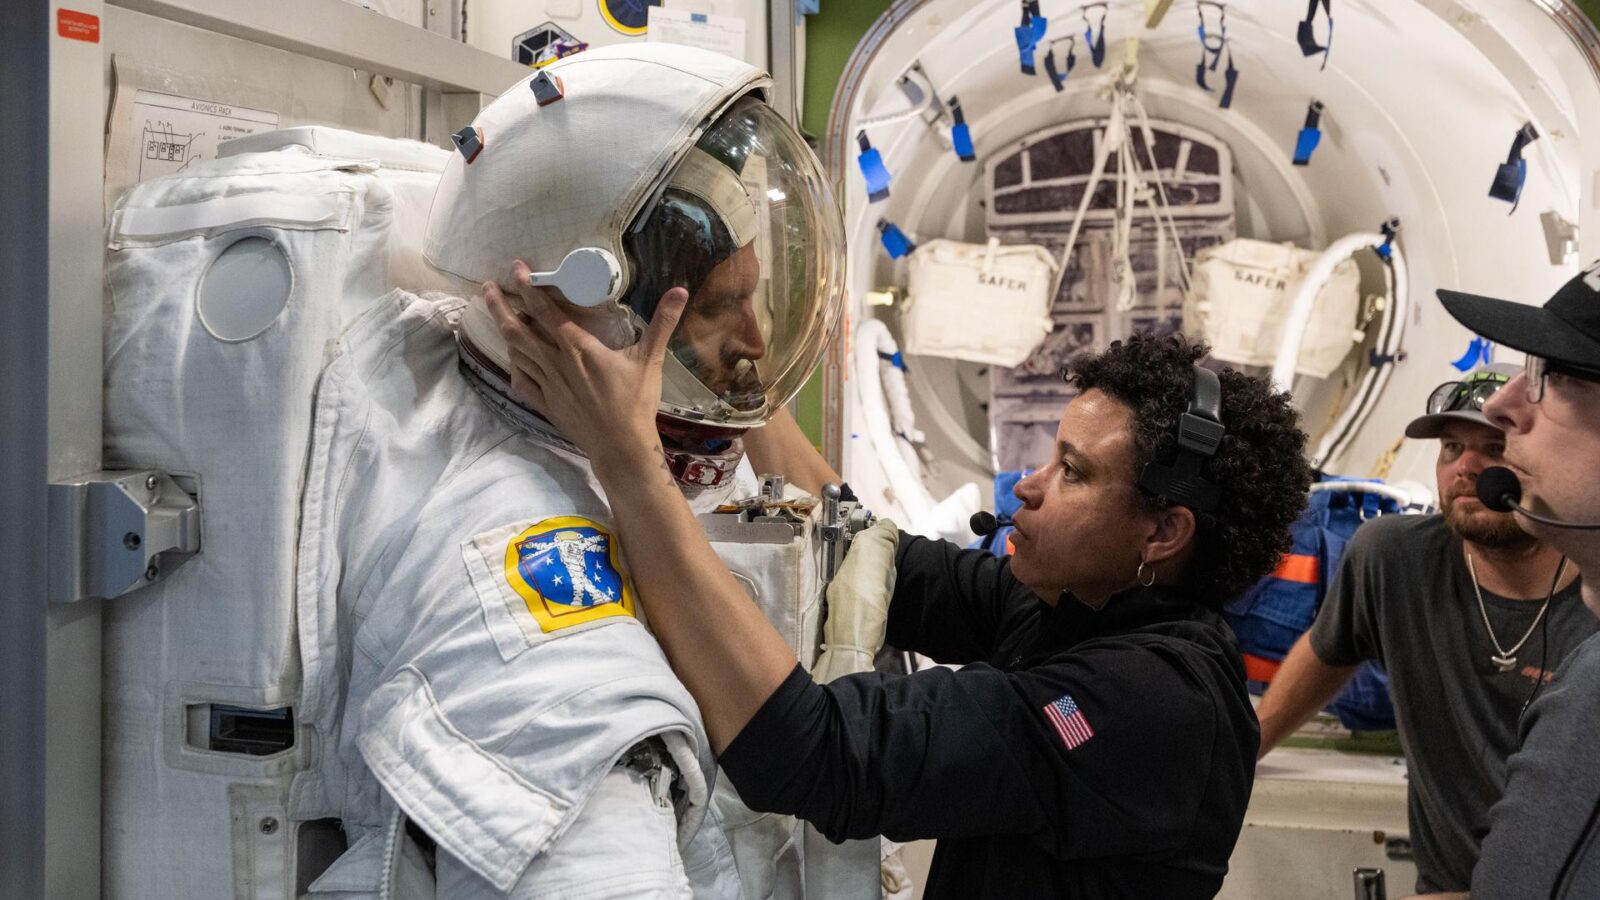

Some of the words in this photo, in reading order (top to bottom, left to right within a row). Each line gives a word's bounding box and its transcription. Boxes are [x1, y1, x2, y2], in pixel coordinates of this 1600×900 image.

[191, 102, 217, 113] AVIONICS
[978, 273, 1027, 292] SAFER
[1234, 271, 1286, 290] SAFER
